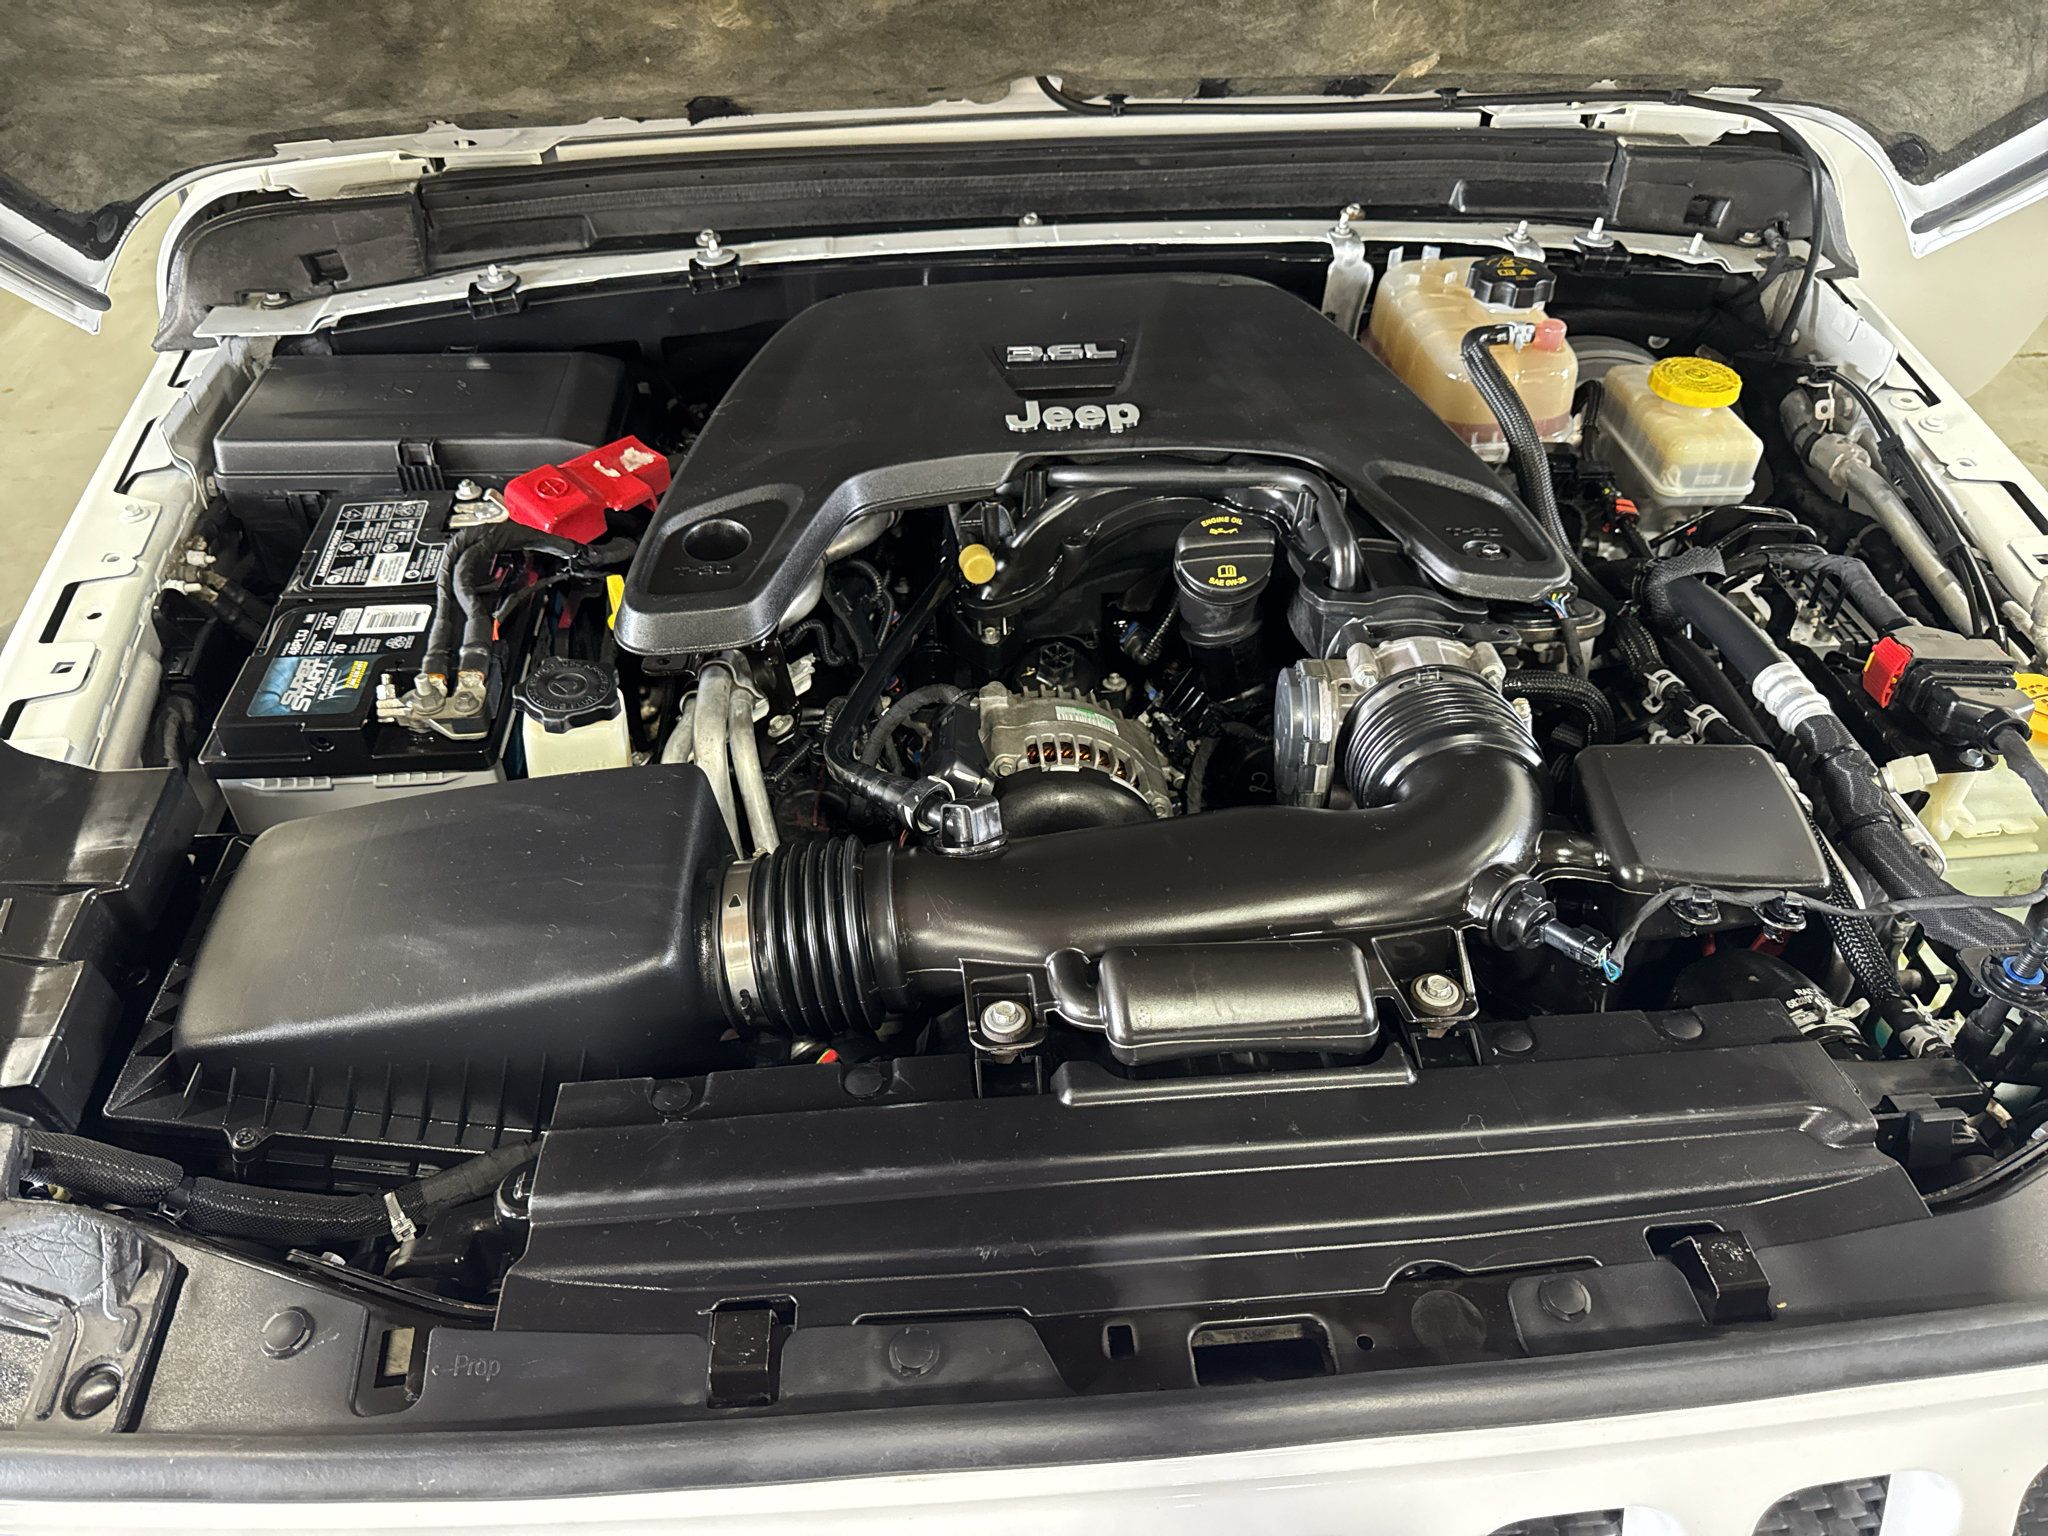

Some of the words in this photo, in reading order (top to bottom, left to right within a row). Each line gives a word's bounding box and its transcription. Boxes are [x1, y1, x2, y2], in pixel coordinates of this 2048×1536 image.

[1006, 343, 1118, 363] 3.6L
[1005, 400, 1141, 433] Jeep
[1201, 516, 1229, 527] ENGINE
[1230, 517, 1243, 525] OIL
[1208, 576, 1225, 586] SAE
[1225, 576, 1248, 587] 0W-20
[323, 615, 338, 630] 120
[310, 640, 327, 655] 760
[333, 643, 348, 655] 70
[280, 658, 316, 706] SUPER
[290, 658, 329, 712] START
[317, 668, 338, 701] PLATINUM
[453, 1354, 501, 1382] Prop
